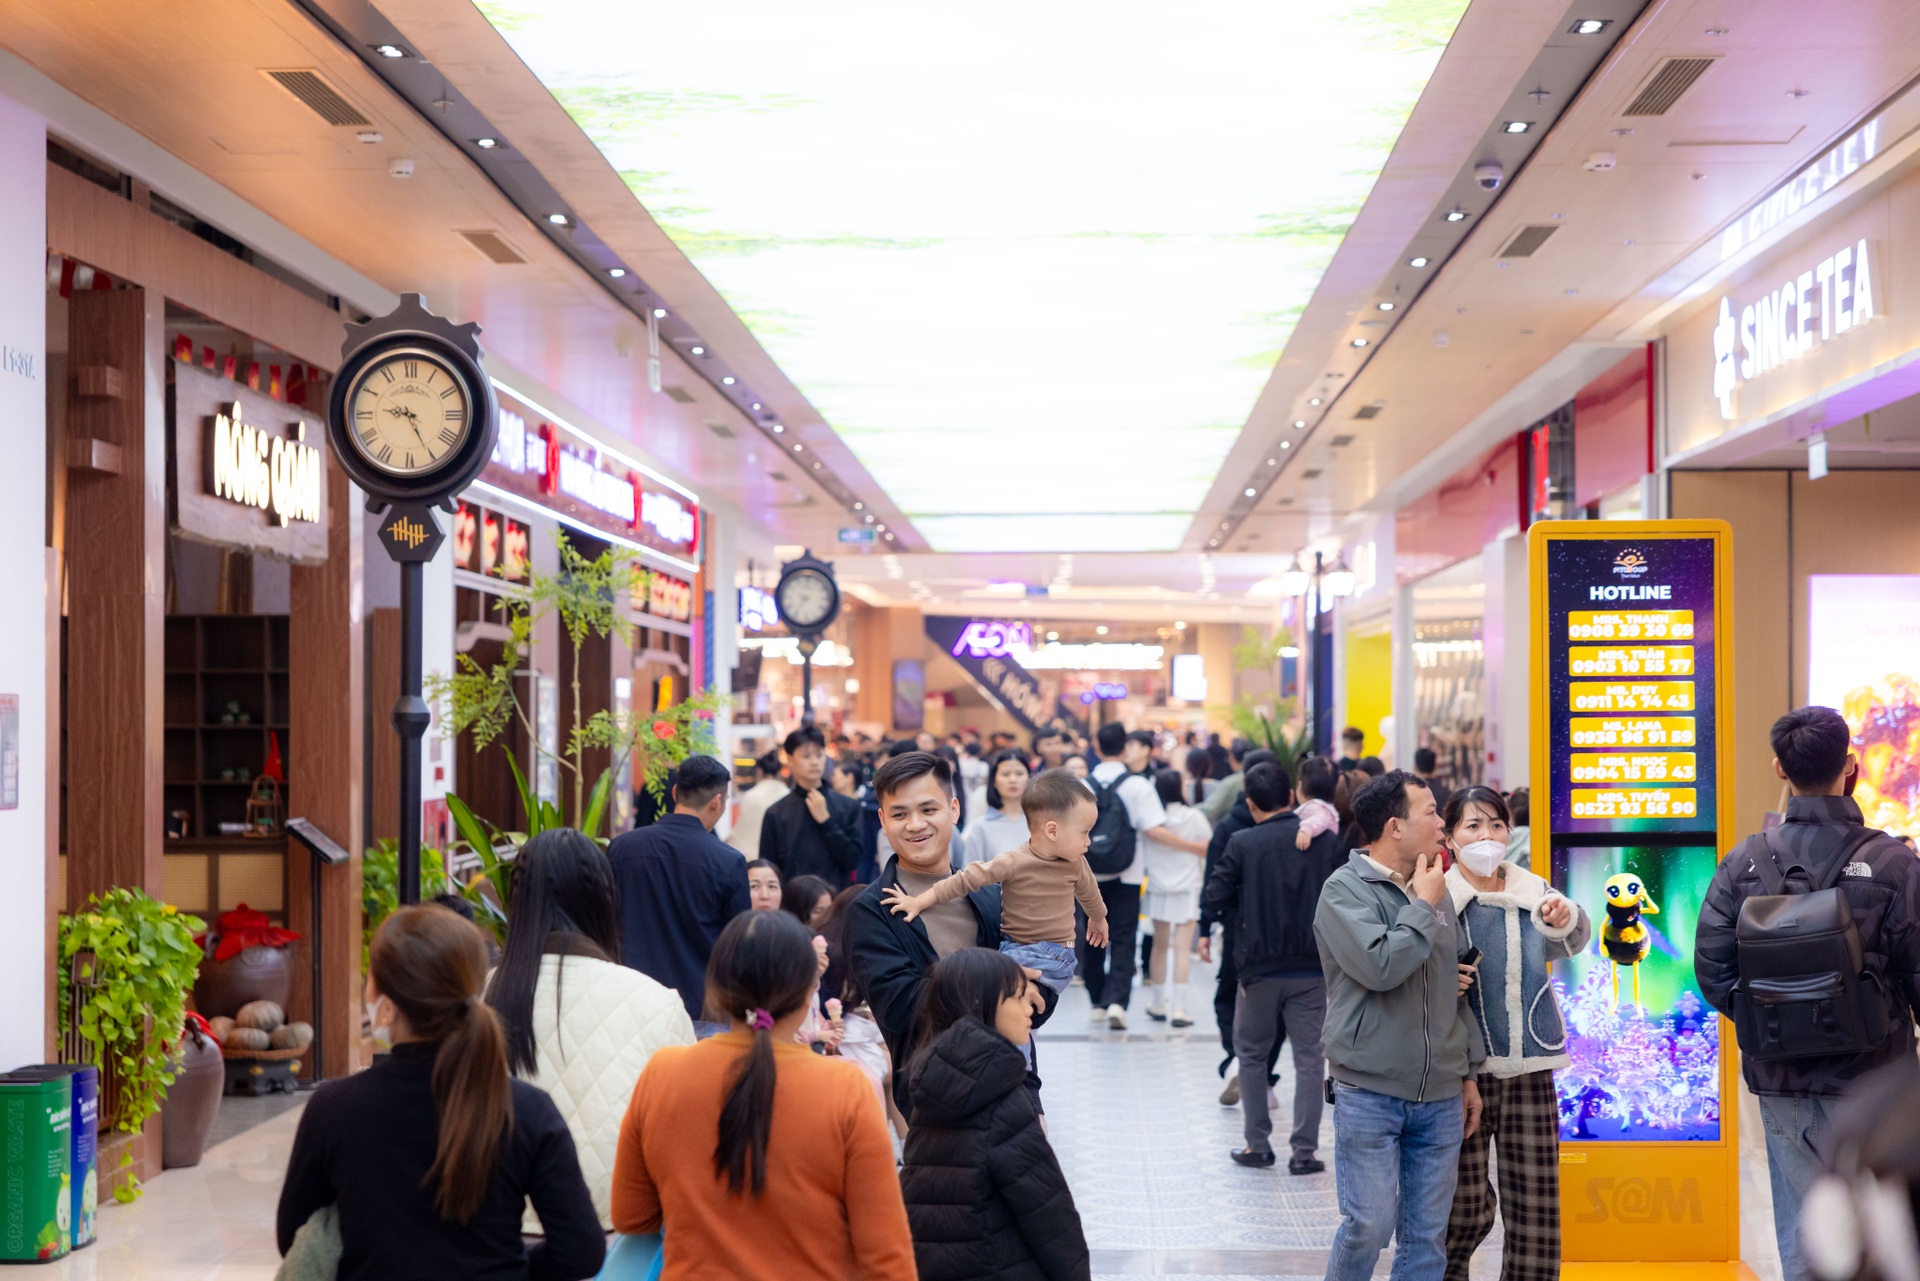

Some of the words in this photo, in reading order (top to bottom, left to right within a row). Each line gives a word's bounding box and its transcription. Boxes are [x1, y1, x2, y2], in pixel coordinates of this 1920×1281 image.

[1741, 270, 1813, 380] SINCE
[1817, 238, 1874, 340] TEA
[1589, 585, 1672, 600] HOTLINE
[1593, 614, 1624, 625] MRS.
[1625, 613, 1669, 624] THANH
[1569, 624, 1614, 637] 0908
[1618, 624, 1641, 637] 39
[1644, 624, 1667, 637] 30
[1671, 624, 1694, 637] 69
[1598, 650, 1628, 660] MRS.
[1572, 659, 1616, 673] 0903
[1620, 659, 1640, 673] 10
[1644, 659, 1665, 673] 55
[1669, 659, 1691, 673] 77
[1606, 686, 1629, 695] MR.
[1631, 685, 1658, 695] DUY
[1575, 694, 1612, 708] 0911
[1616, 694, 1636, 708] 14
[1640, 694, 1663, 708] 74
[1667, 694, 1689, 708] 43
[1602, 721, 1626, 731] MS.
[1627, 721, 1663, 730] LANA
[1573, 730, 1617, 744] 0938
[1621, 730, 1644, 744] 96
[1647, 730, 1667, 744] 91
[1671, 730, 1692, 744] 59
[1598, 757, 1629, 767] MRS.
[1573, 766, 1619, 779] 0904
[1622, 766, 1641, 779] 15
[1645, 766, 1667, 779] 59
[1671, 766, 1694, 779] 43
[1597, 793, 1628, 802] MRS.
[1573, 801, 1615, 815] 0522
[1619, 801, 1641, 815] 93
[1645, 801, 1668, 815] 56
[1671, 801, 1694, 815] 90
[7, 1099, 24, 1163] WASTE
[1574, 1177, 1704, 1225] S@M
[7, 1166, 24, 1253] ORGANIC
